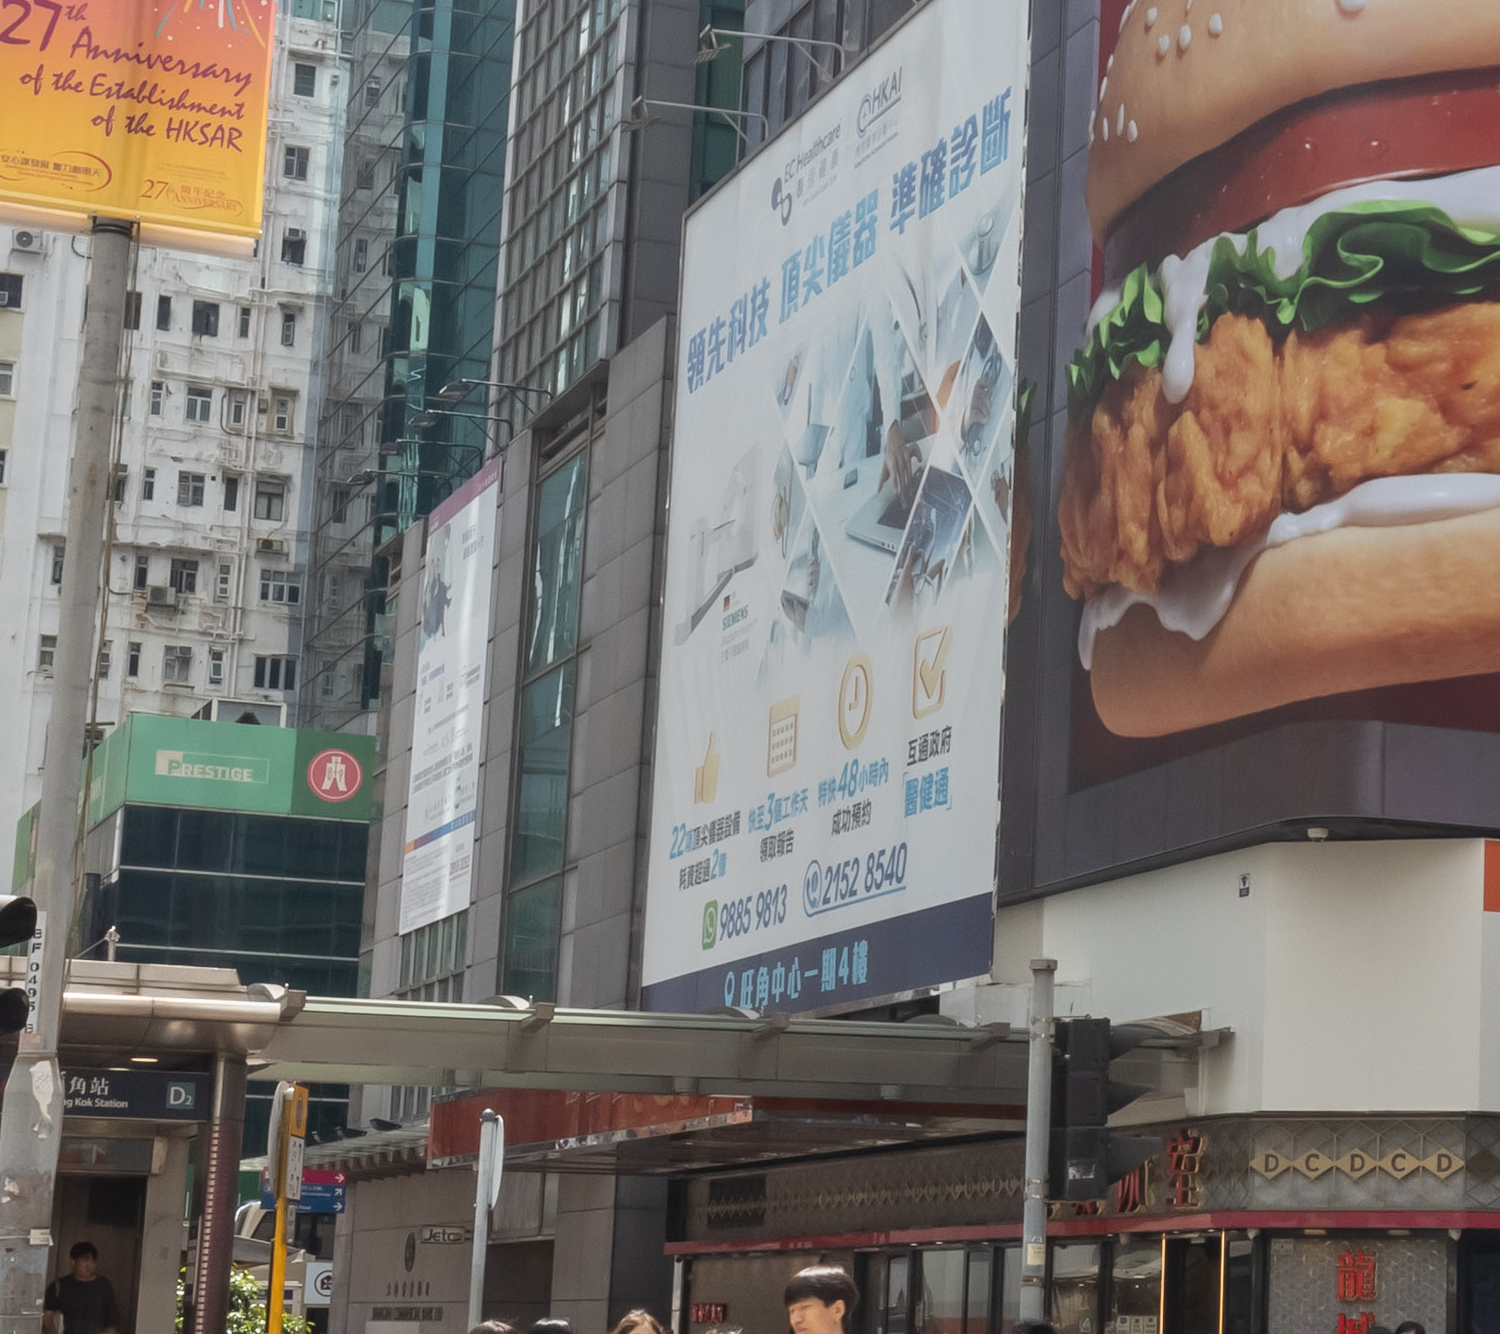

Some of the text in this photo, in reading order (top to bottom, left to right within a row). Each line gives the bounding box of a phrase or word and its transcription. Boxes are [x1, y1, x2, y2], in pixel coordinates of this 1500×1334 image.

[70, 26, 252, 96] Anniversary
[20, 64, 244, 120] of the Establishment
[91, 106, 242, 152] of the HKSAR
[687, 85, 1012, 394] 領先科技 頂尖儀器 準確診斷
[167, 759, 253, 782] PRESTIGE
[823, 843, 908, 905] 2152 8540
[719, 884, 788, 942] 9885 9813
[740, 939, 869, 1010] 旺角中心一期4樓
[74, 1097, 93, 1107] Kok
[94, 1098, 129, 1109] Station
